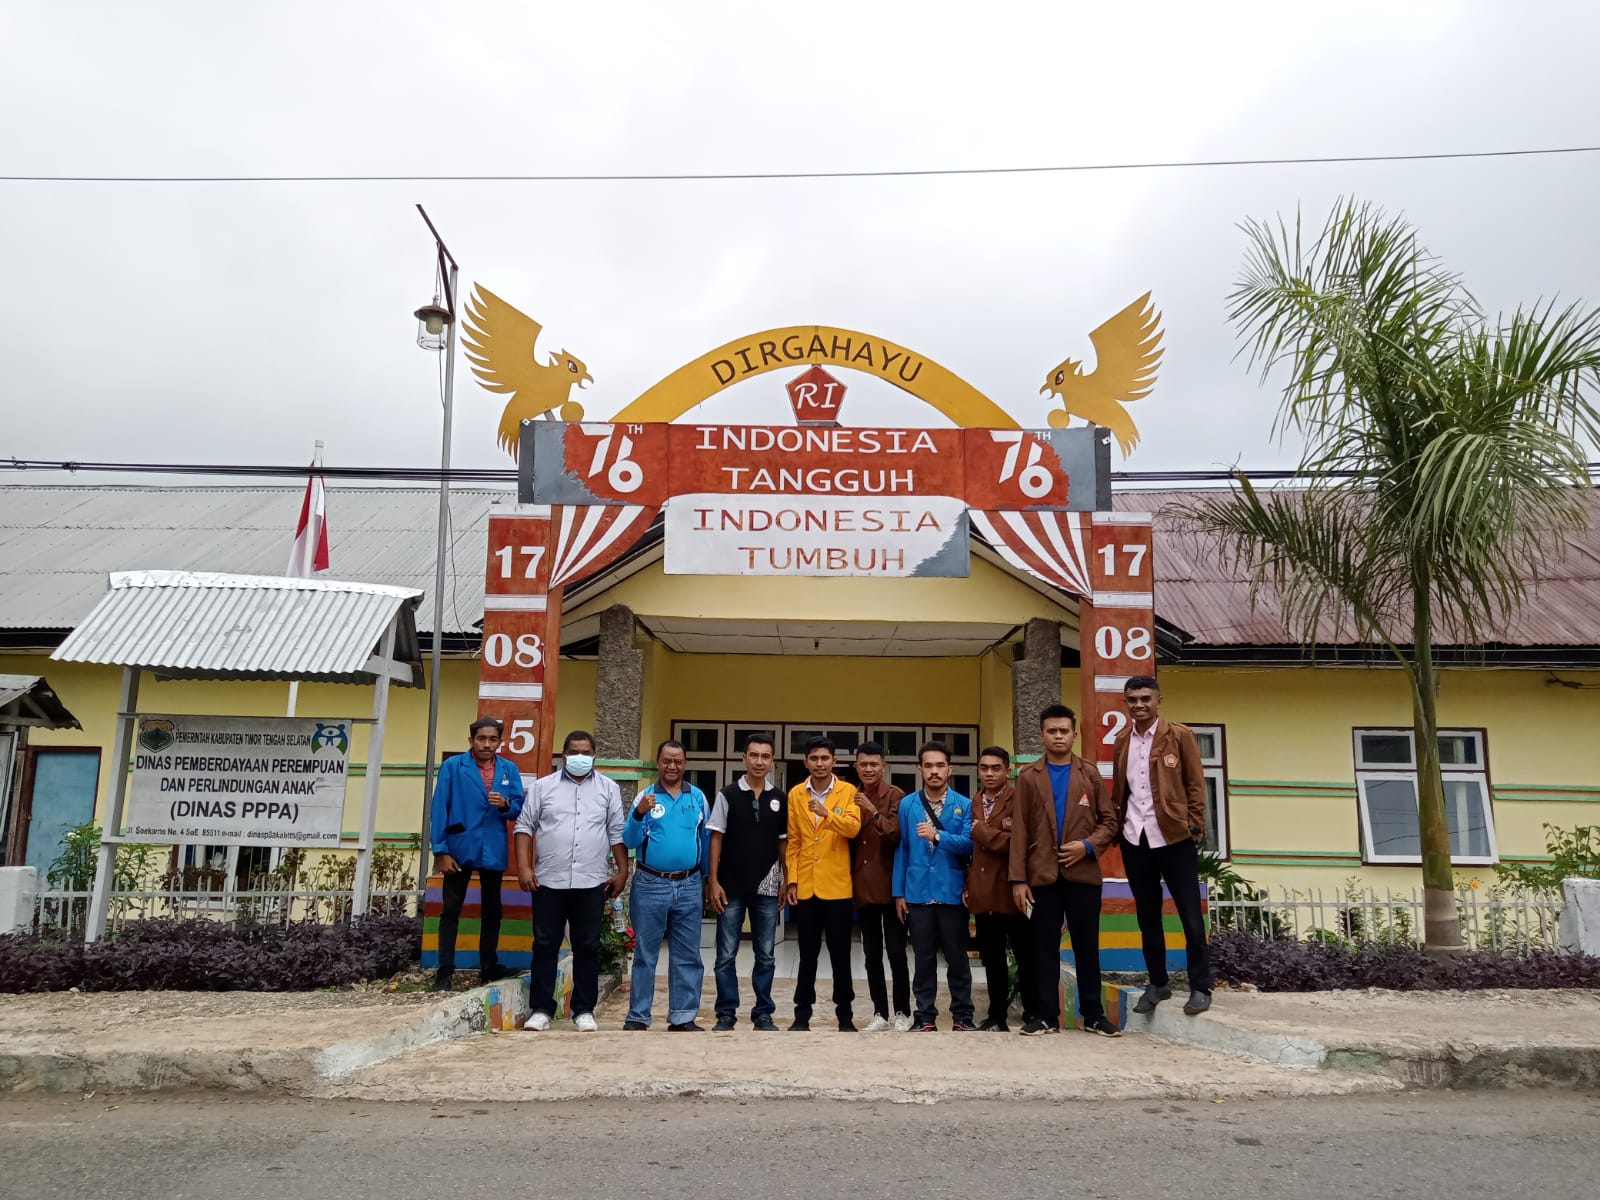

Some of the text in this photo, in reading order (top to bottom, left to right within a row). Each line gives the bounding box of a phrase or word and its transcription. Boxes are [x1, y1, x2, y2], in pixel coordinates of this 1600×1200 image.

[710, 333, 924, 386] DIRGAHAYU
[794, 382, 838, 410] RI
[695, 426, 938, 454] INDONESIA
[579, 423, 644, 494] 76 TH
[989, 430, 1054, 499] 76
[721, 466, 914, 493] TANGGUH
[693, 508, 942, 533] INDONESIA
[495, 545, 546, 579] 17
[738, 546, 904, 571] TUMBUH
[1097, 543, 1148, 577] 17
[484, 633, 542, 668] 08
[1095, 625, 1152, 660] 08
[175, 731, 311, 747] PEMERINTAH KABUPATEN TIMOR TENGAH SELATAN
[136, 755, 345, 774] DINAS PEMBERDAYAAN PEREMPUAN
[160, 777, 316, 795] DAN PERLINDUNGAN ANAK
[170, 801, 299, 824] (DINAS PPPA)
[135, 826, 166, 835] Soekarno
